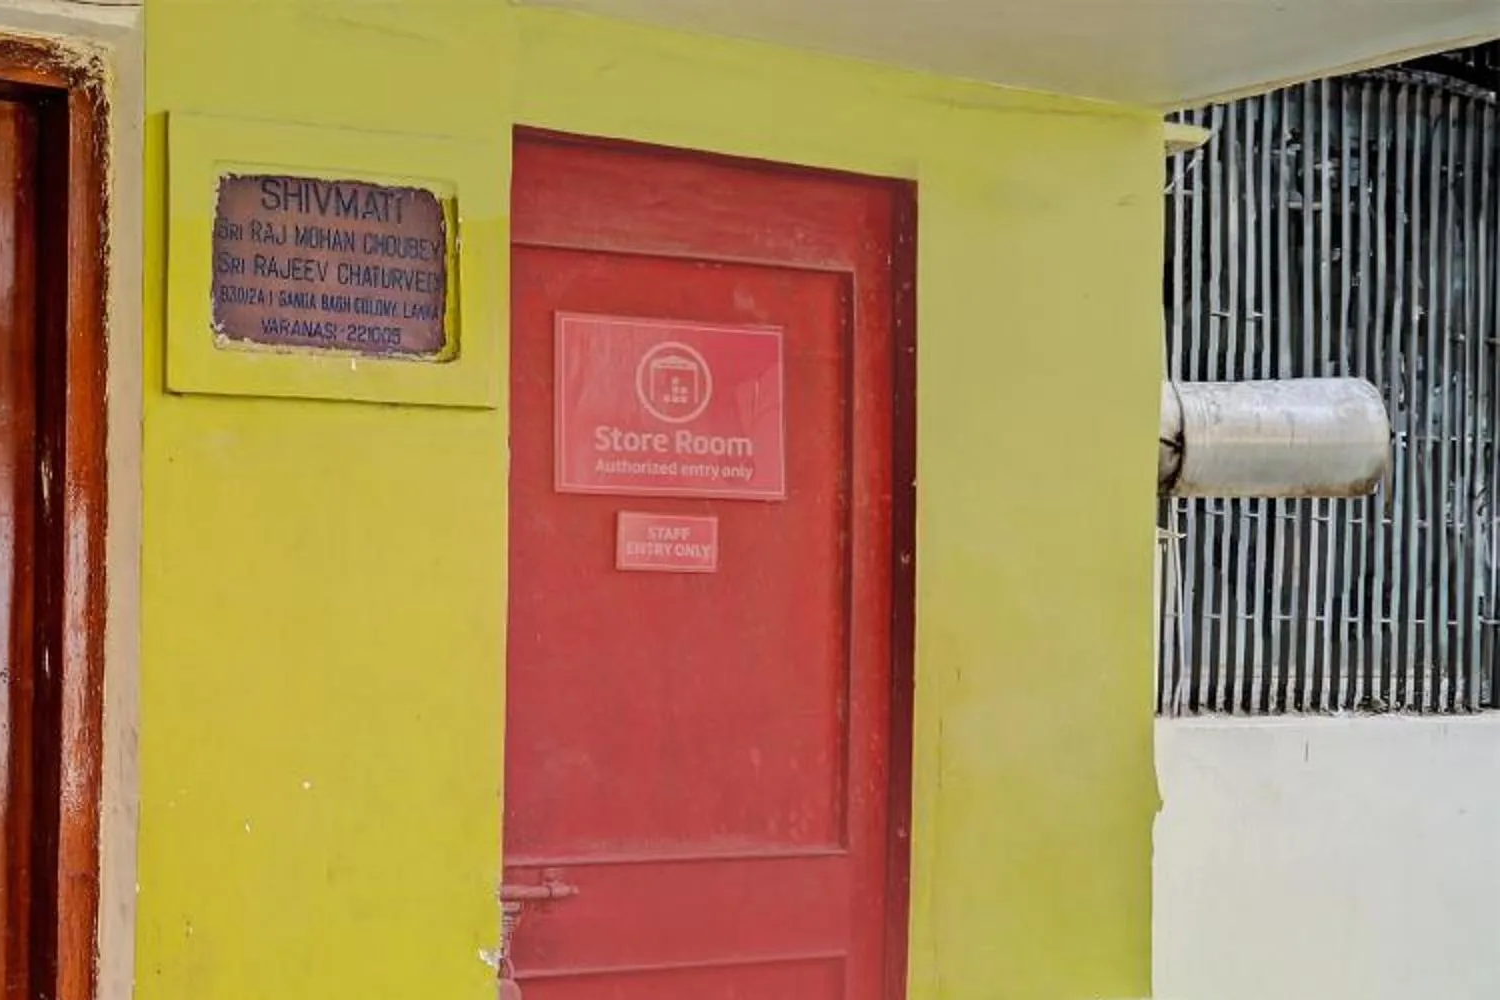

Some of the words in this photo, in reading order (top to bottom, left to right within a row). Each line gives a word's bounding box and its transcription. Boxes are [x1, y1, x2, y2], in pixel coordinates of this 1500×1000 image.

[260, 179, 403, 225] SHIVMATI
[251, 219, 287, 245] RAJ
[295, 225, 355, 252] MOHAN
[363, 232, 442, 261] CHOUBEY
[253, 254, 330, 282] RAJEEV
[595, 425, 668, 453] Store
[676, 429, 753, 457] Room
[595, 458, 678, 476] Authorized
[681, 463, 719, 481] entry
[722, 464, 753, 481] only
[647, 527, 691, 541] STAFF
[626, 542, 672, 557] ENTRY
[674, 544, 712, 559] ONLY
